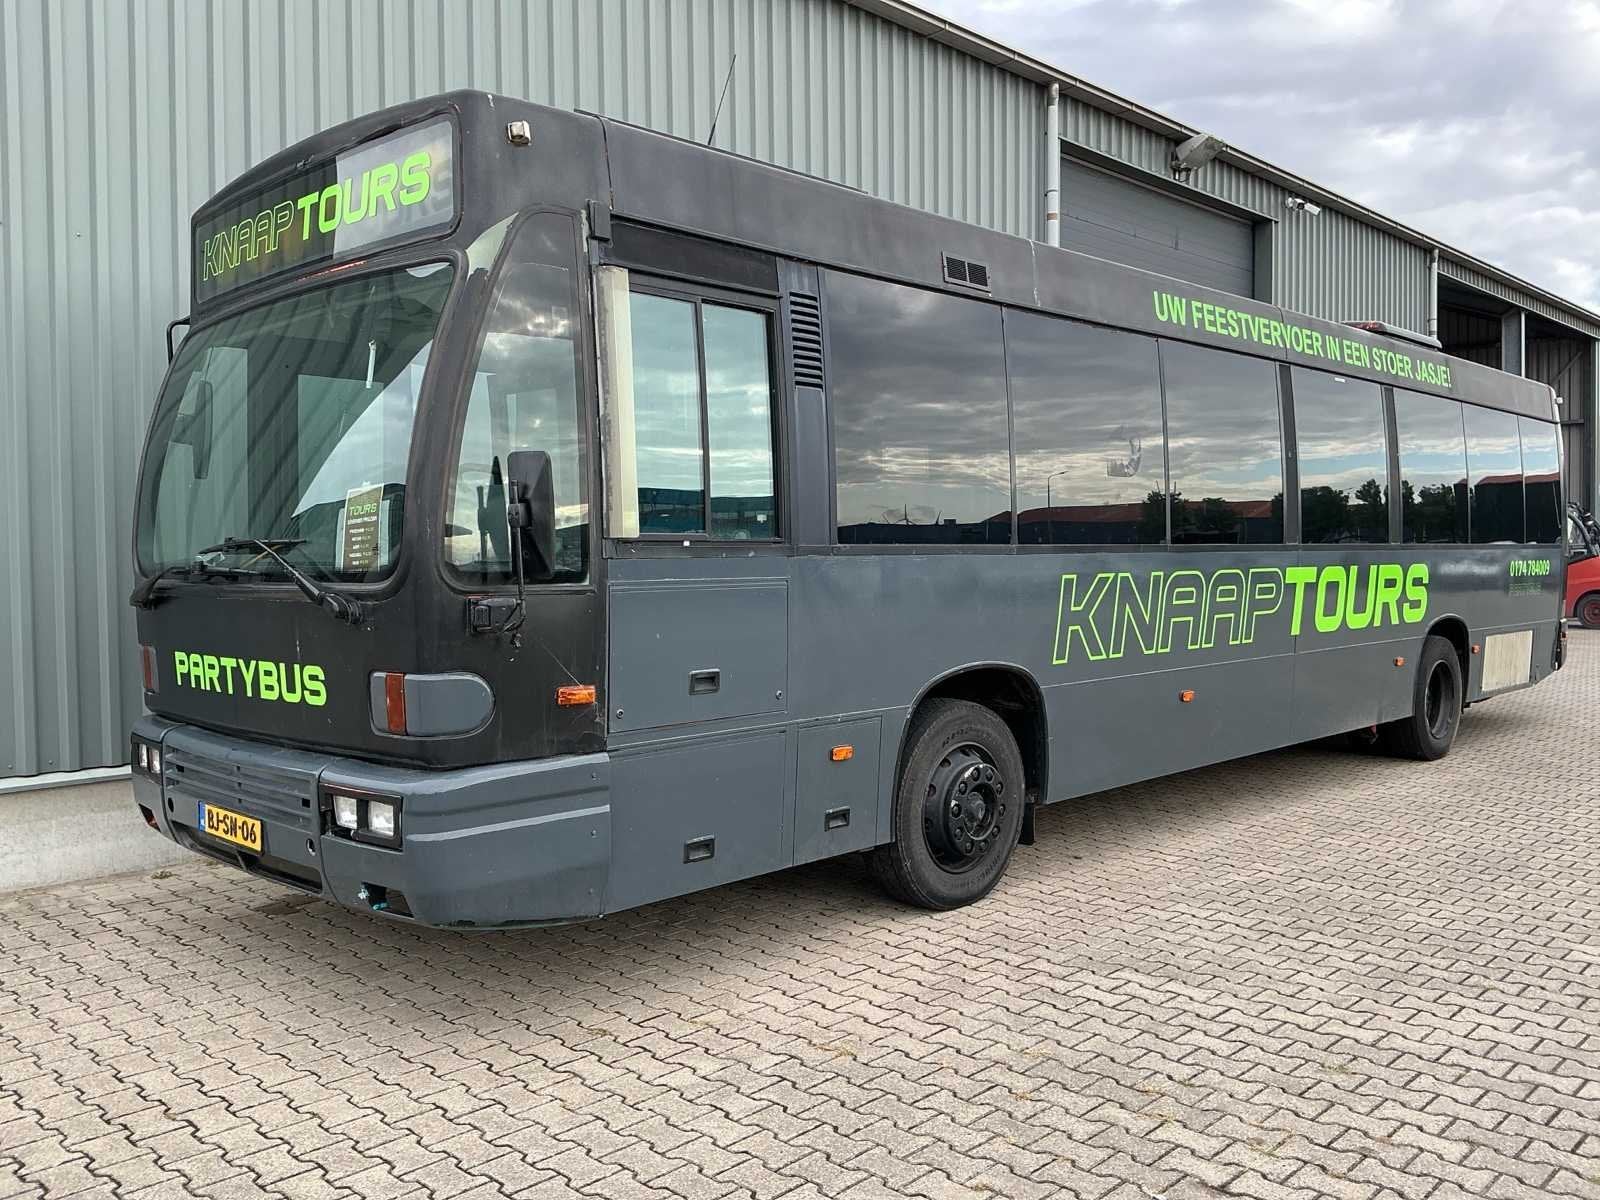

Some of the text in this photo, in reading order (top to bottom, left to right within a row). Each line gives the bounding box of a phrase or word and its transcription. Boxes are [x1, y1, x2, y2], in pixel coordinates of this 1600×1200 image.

[1153, 290, 1452, 388] UW FEESTVERVOER IN EEN STOER JASJE!
[174, 651, 328, 707] PARTYBUS
[207, 808, 257, 845] BJ-SN-06
